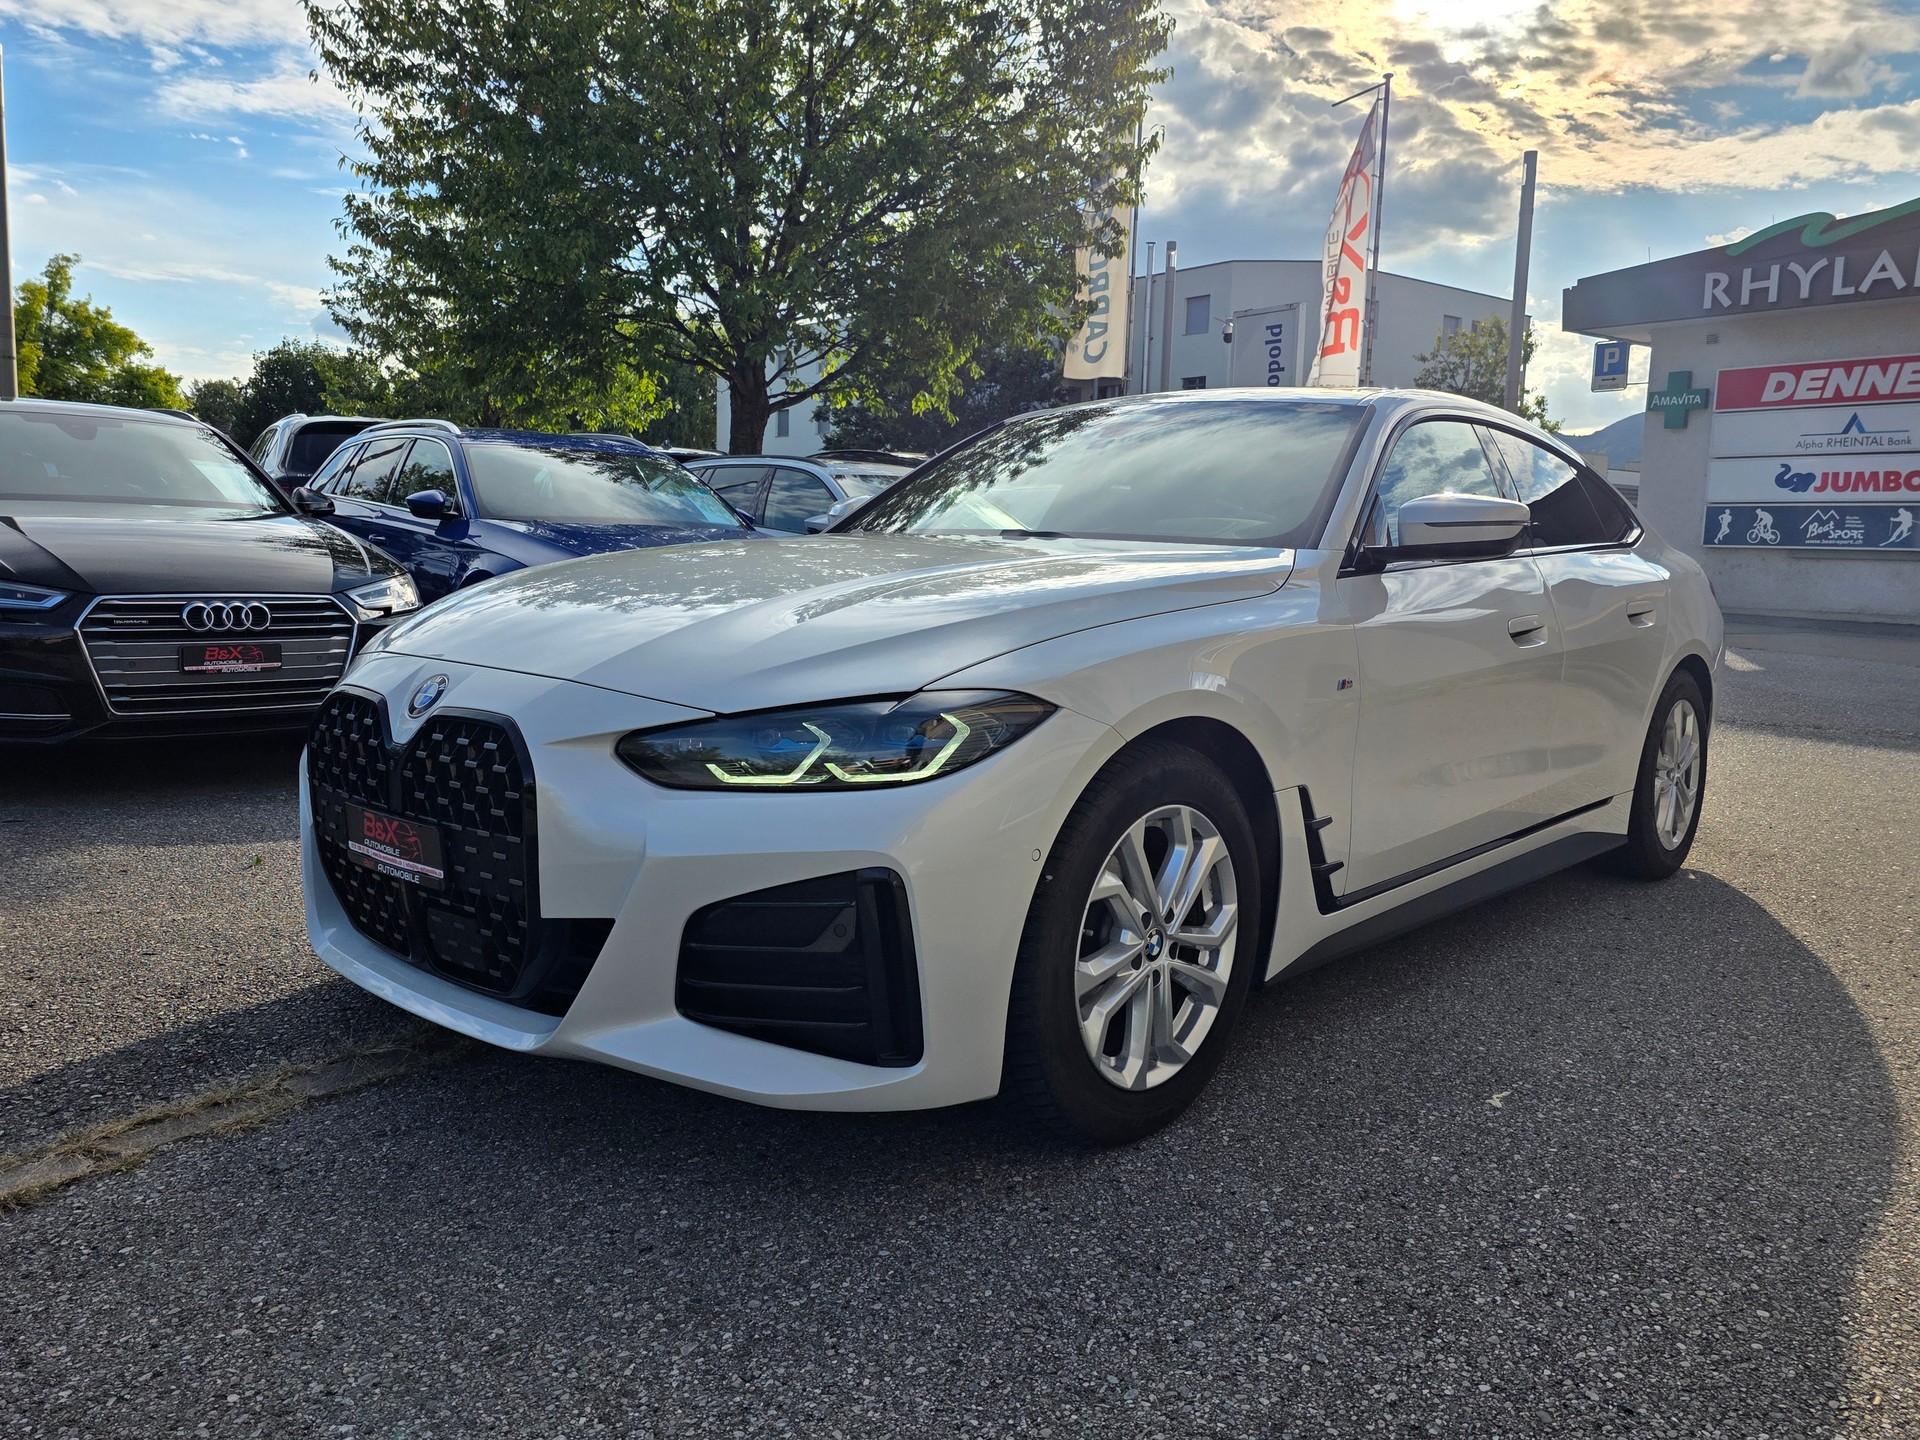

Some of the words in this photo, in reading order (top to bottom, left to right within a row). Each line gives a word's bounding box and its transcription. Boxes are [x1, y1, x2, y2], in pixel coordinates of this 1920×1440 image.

[1703, 247, 1920, 310] RHYLA
[1603, 348, 1620, 373] P
[1650, 393, 1701, 408] AMAVITA
[1795, 440, 1823, 450] Alpha
[1826, 436, 1884, 448] RHEINTAL
[1887, 436, 1912, 446] Bank
[1813, 470, 1920, 493] JUMBO
[1806, 520, 1835, 539] Beat
[204, 645, 244, 660] B&X
[363, 811, 400, 846] B&X
[364, 838, 400, 856] AUTOMOBILE
[377, 863, 420, 884] AUTOMOBILE
